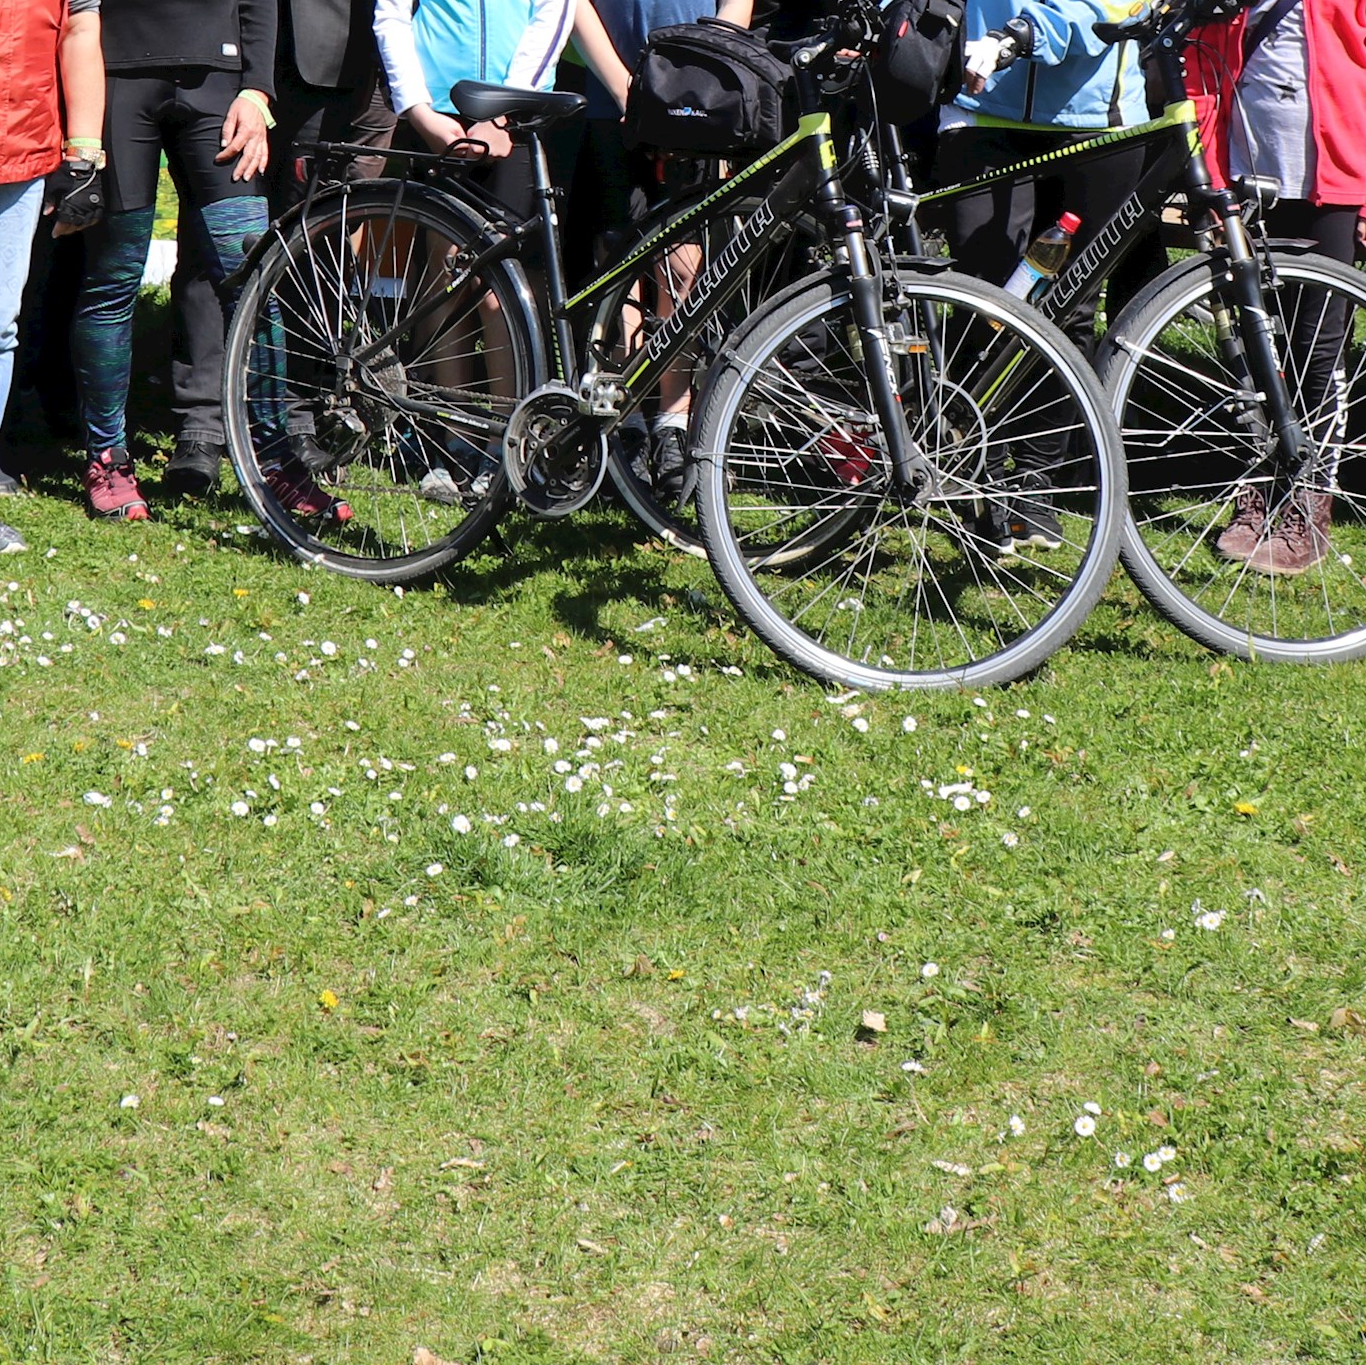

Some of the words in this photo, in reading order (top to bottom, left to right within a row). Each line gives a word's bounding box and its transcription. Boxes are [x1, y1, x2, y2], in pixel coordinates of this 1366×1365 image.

[647, 198, 774, 361] ATLANTA
[1040, 192, 1145, 322] TLANTA
[1334, 368, 1349, 438] ACTIVE
